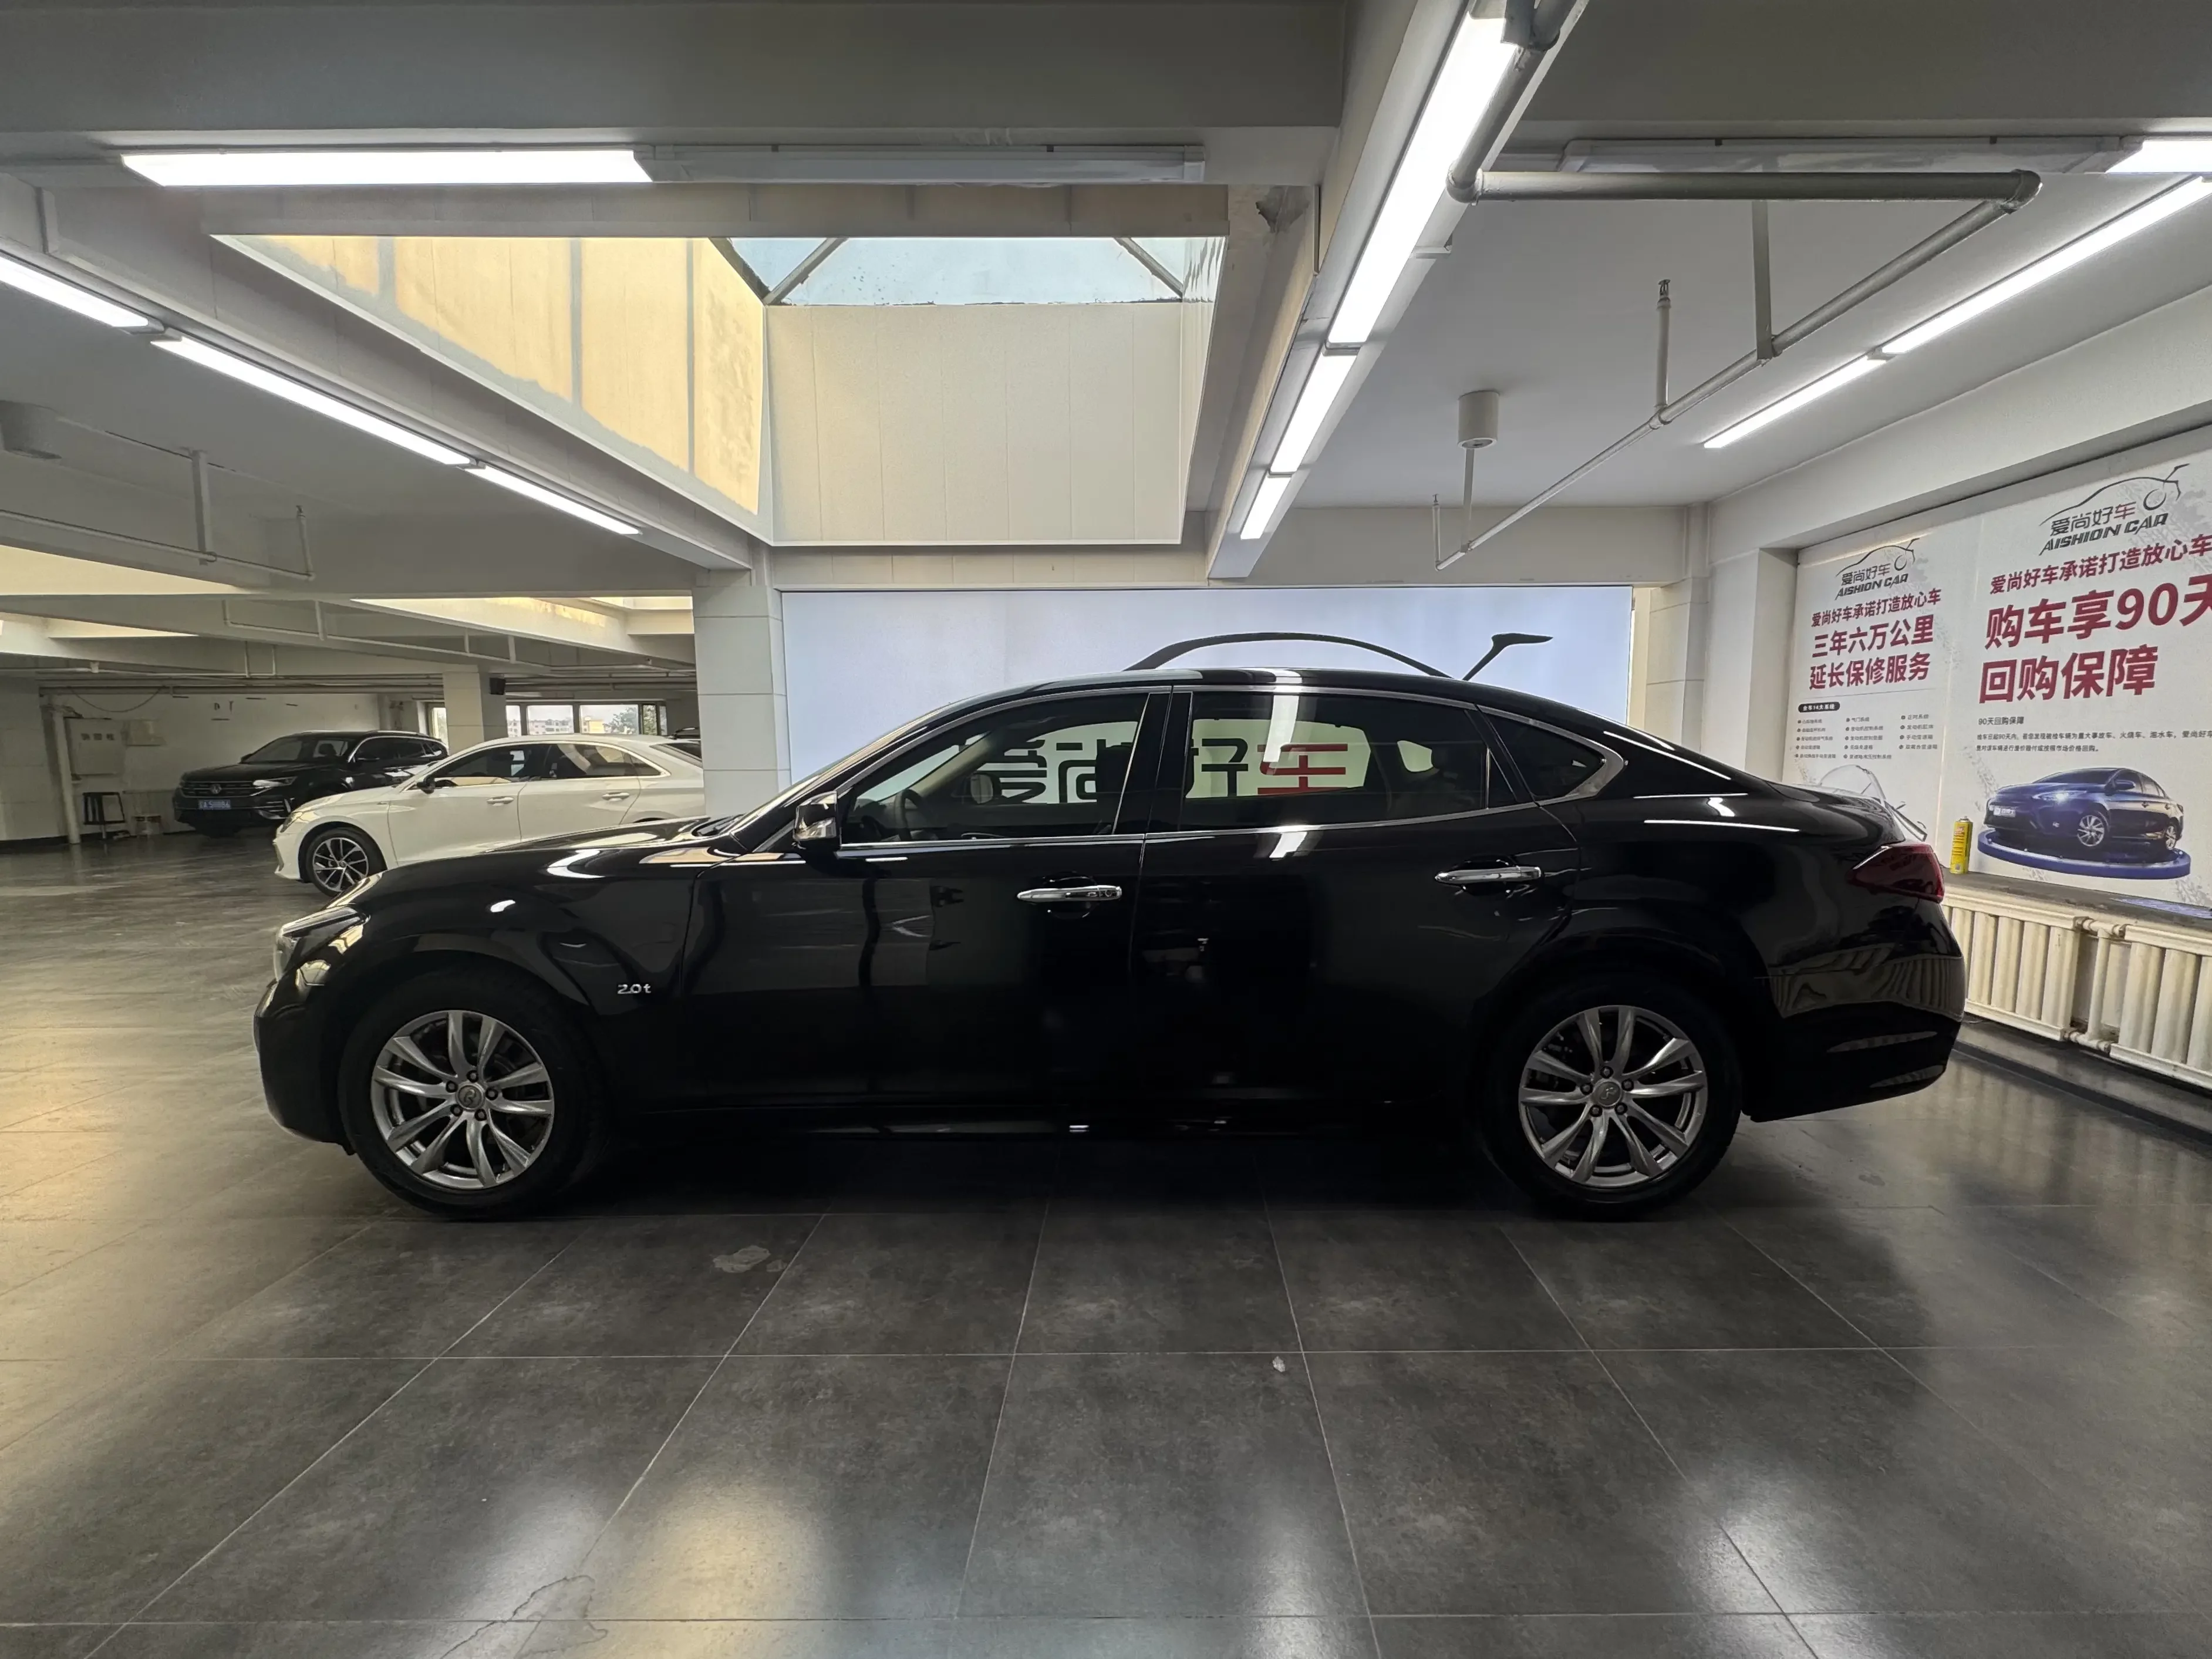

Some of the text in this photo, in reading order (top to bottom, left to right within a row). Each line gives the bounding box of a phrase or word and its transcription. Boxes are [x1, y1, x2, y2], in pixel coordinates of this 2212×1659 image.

[2039, 512, 2169, 556] AISHION CAR
[2050, 501, 2136, 536] 爱尚好车
[1841, 563, 1891, 586] 爱尚好车
[1990, 534, 2212, 595] 爱尚好车承诺打造放心车
[1811, 588, 1942, 628] 爱尚好车承诺打造放心车
[1834, 579, 1883, 601] AISHION
[1984, 573, 2212, 650] 购车享90天
[1812, 614, 1934, 658] 三年六万公里
[1809, 652, 1931, 690] 延长保修服务
[1979, 643, 2159, 704] 回购保障
[1978, 716, 2024, 726] 90天回购保障
